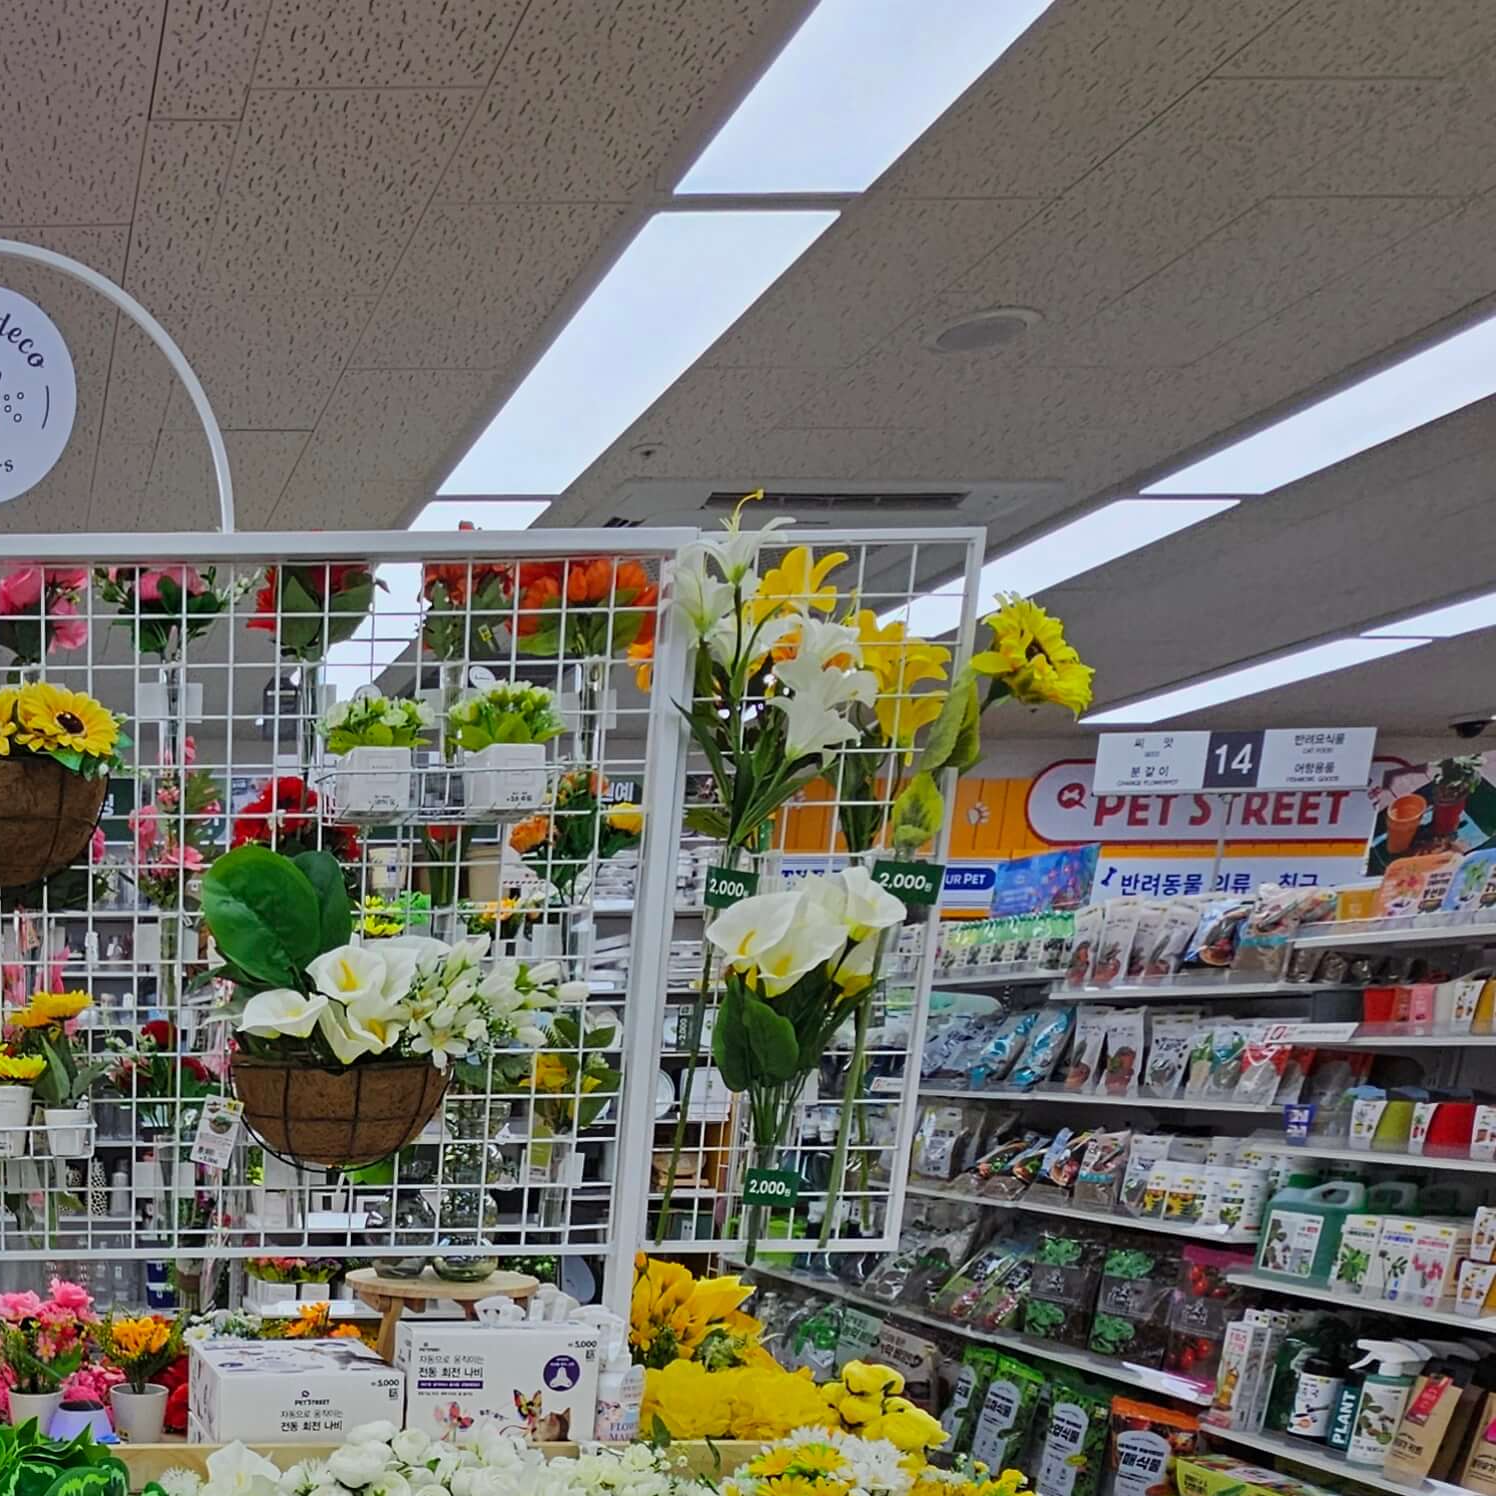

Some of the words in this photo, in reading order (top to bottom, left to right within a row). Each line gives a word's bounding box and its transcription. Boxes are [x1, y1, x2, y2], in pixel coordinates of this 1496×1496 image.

[1215, 743, 1253, 774] 14
[1093, 791, 1178, 826] PET
[1188, 790, 1352, 826] STREET
[963, 873, 987, 885] PET
[1121, 872, 1203, 896] 반려동물
[418, 1355, 450, 1364] 자동으로
[418, 1367, 439, 1378] 전동
[441, 1367, 461, 1378] 회전
[464, 1367, 484, 1378] 나비
[281, 1410, 311, 1418] 자동으로
[1332, 1390, 1356, 1444] PLANT
[280, 1422, 299, 1432] 전동
[302, 1421, 321, 1431] 회전
[324, 1420, 343, 1431] 나비
